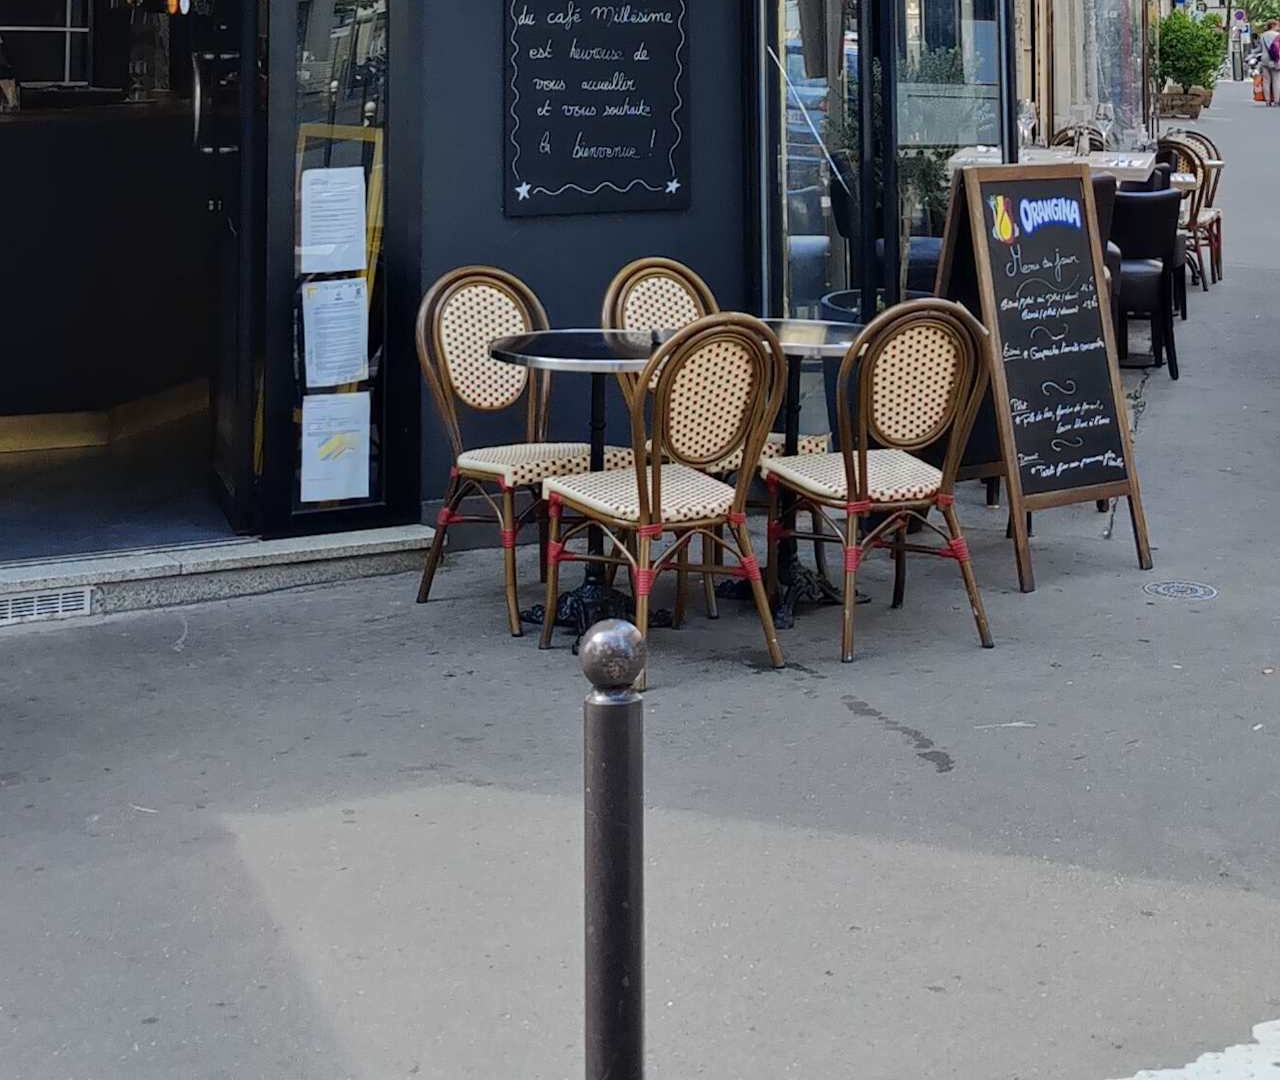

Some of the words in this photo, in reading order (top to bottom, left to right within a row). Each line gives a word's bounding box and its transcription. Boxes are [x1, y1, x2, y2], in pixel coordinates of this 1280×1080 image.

[518, 5, 536, 26] du
[547, 1, 583, 30] café
[529, 39, 553, 60] est
[633, 42, 651, 61] de
[533, 78, 566, 91] vous
[581, 71, 636, 91] accueillir
[537, 99, 553, 116] et
[562, 104, 597, 116] vous
[602, 96, 652, 117] souhaite
[539, 131, 552, 155] la
[572, 131, 641, 158] bienvenue
[1020, 198, 1080, 233] ORANGINA
